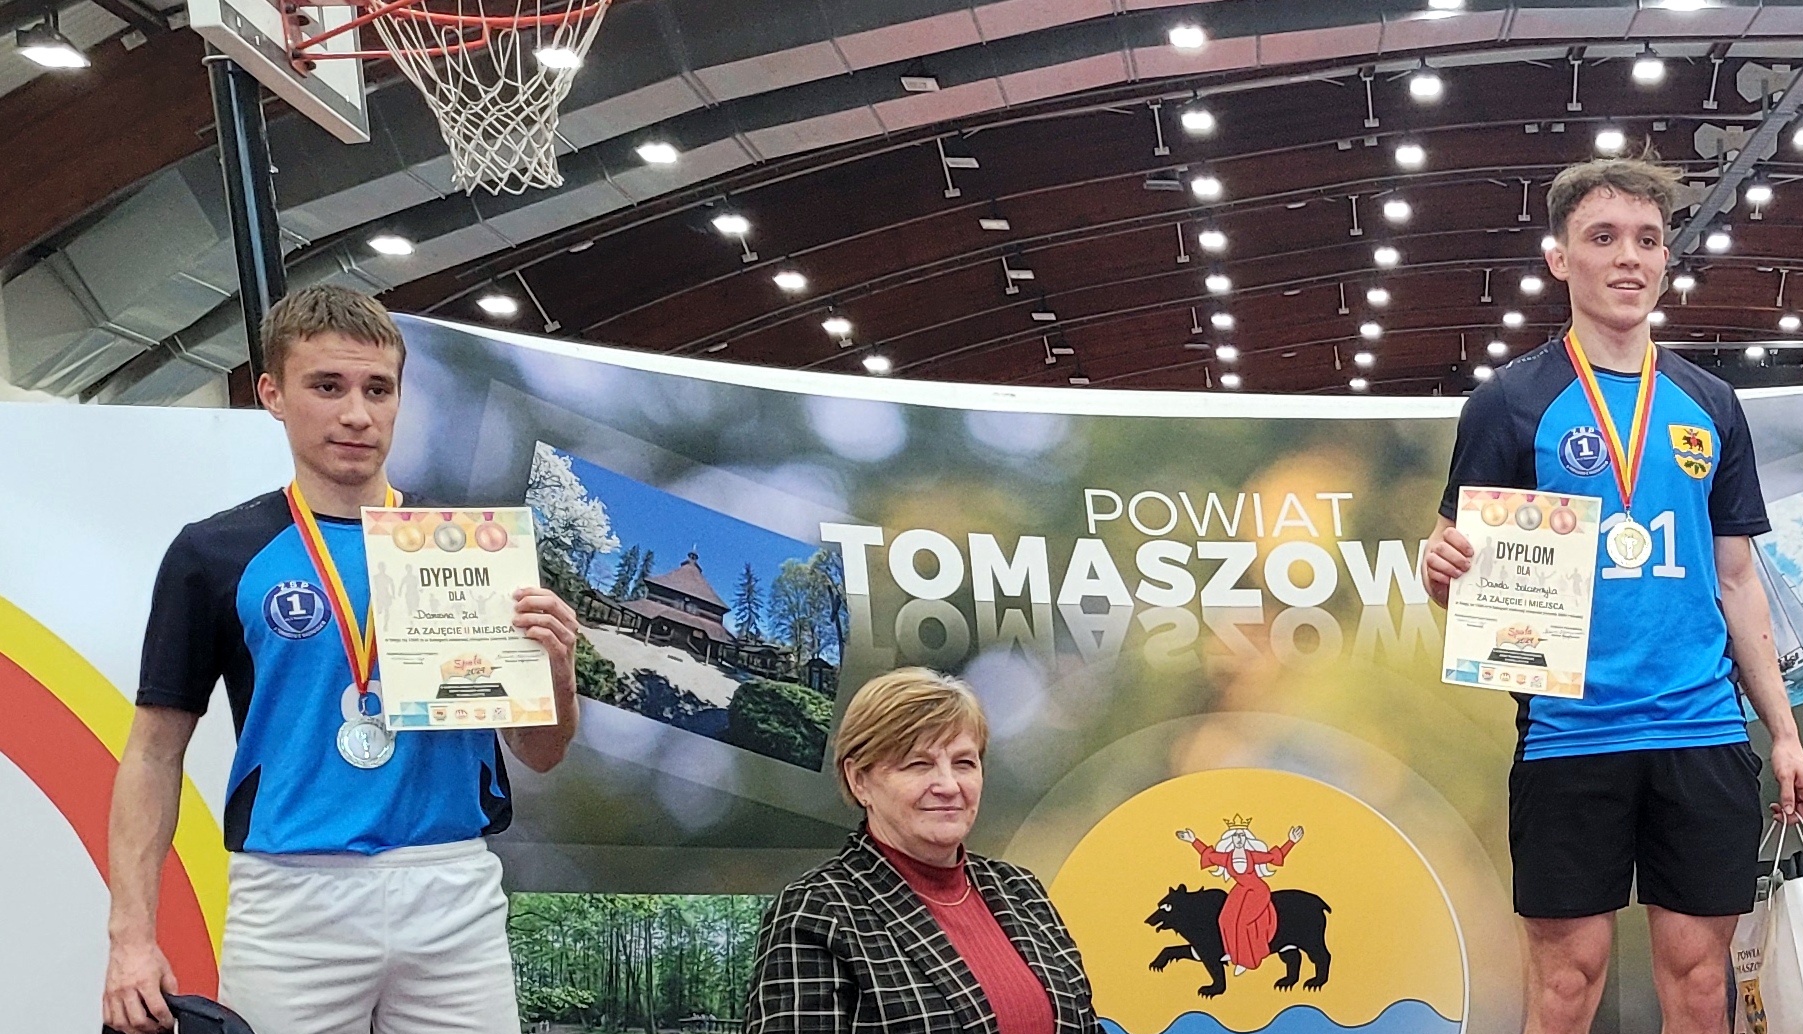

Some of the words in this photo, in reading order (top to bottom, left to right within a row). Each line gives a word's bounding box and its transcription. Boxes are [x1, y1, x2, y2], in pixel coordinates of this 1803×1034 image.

[1577, 437, 1594, 457] 1
[1084, 488, 1353, 538] POWIAT
[1496, 541, 1554, 566] DYPLOM
[419, 567, 490, 587] DYPLOM
[1516, 565, 1531, 577] DLA
[286, 593, 307, 616] 1
[448, 590, 466, 601] DLA
[1477, 594, 1488, 602] ZA
[1490, 595, 1523, 606] ZAJĘCIE
[1528, 600, 1564, 611] MIEJSCA
[406, 627, 420, 635] ZA
[422, 626, 462, 637] ZAJĘCIE
[472, 625, 516, 634] MIEJSCA
